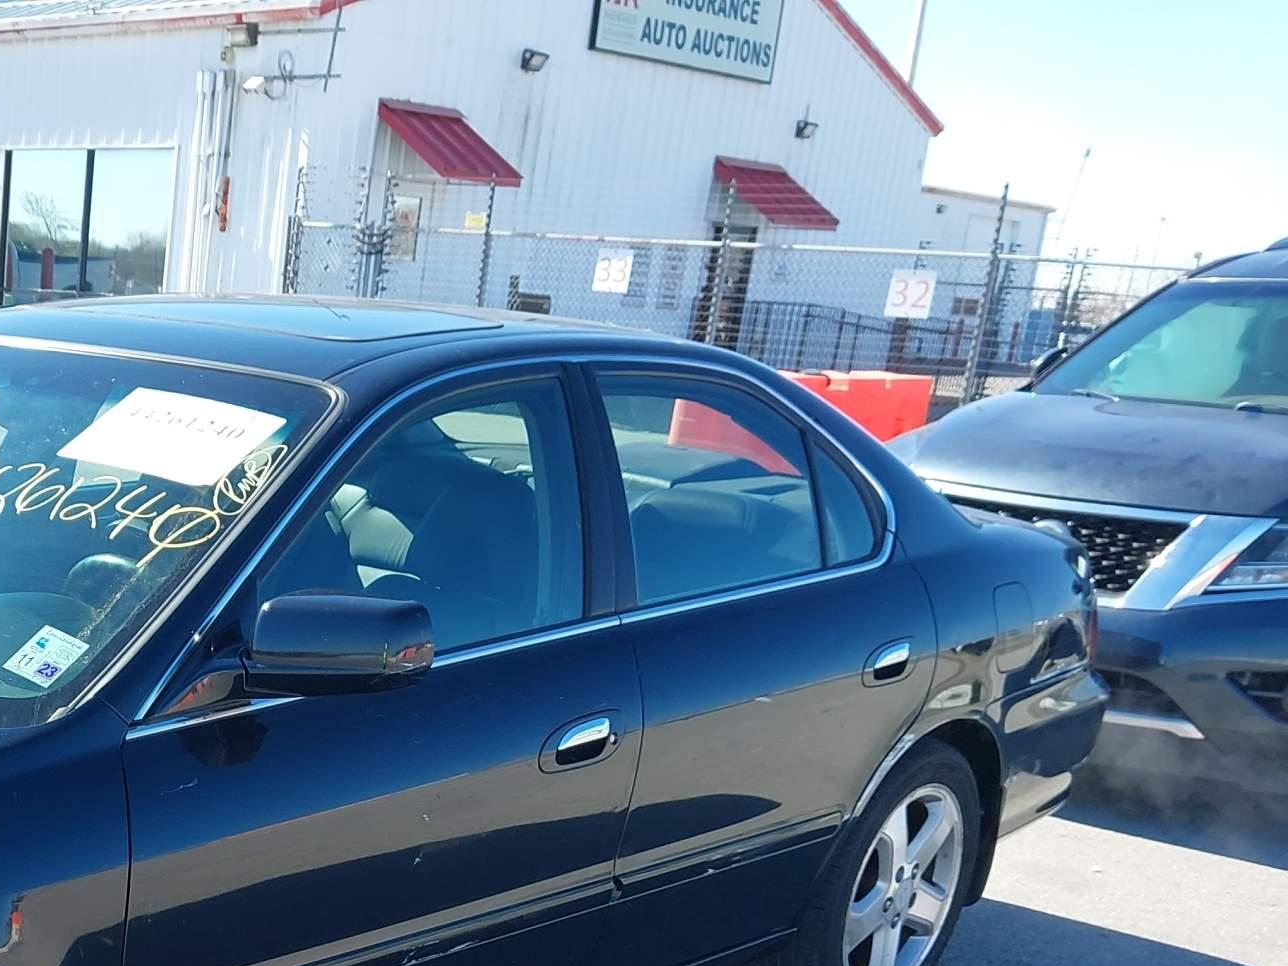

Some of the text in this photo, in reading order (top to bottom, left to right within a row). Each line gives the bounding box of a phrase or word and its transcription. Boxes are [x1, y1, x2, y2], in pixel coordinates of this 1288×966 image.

[640, 17, 687, 49] AUTO
[690, 28, 772, 67] AUCTIONS
[598, 257, 627, 282] 33
[890, 279, 930, 309] 32
[18, 654, 58, 678] 11 23
